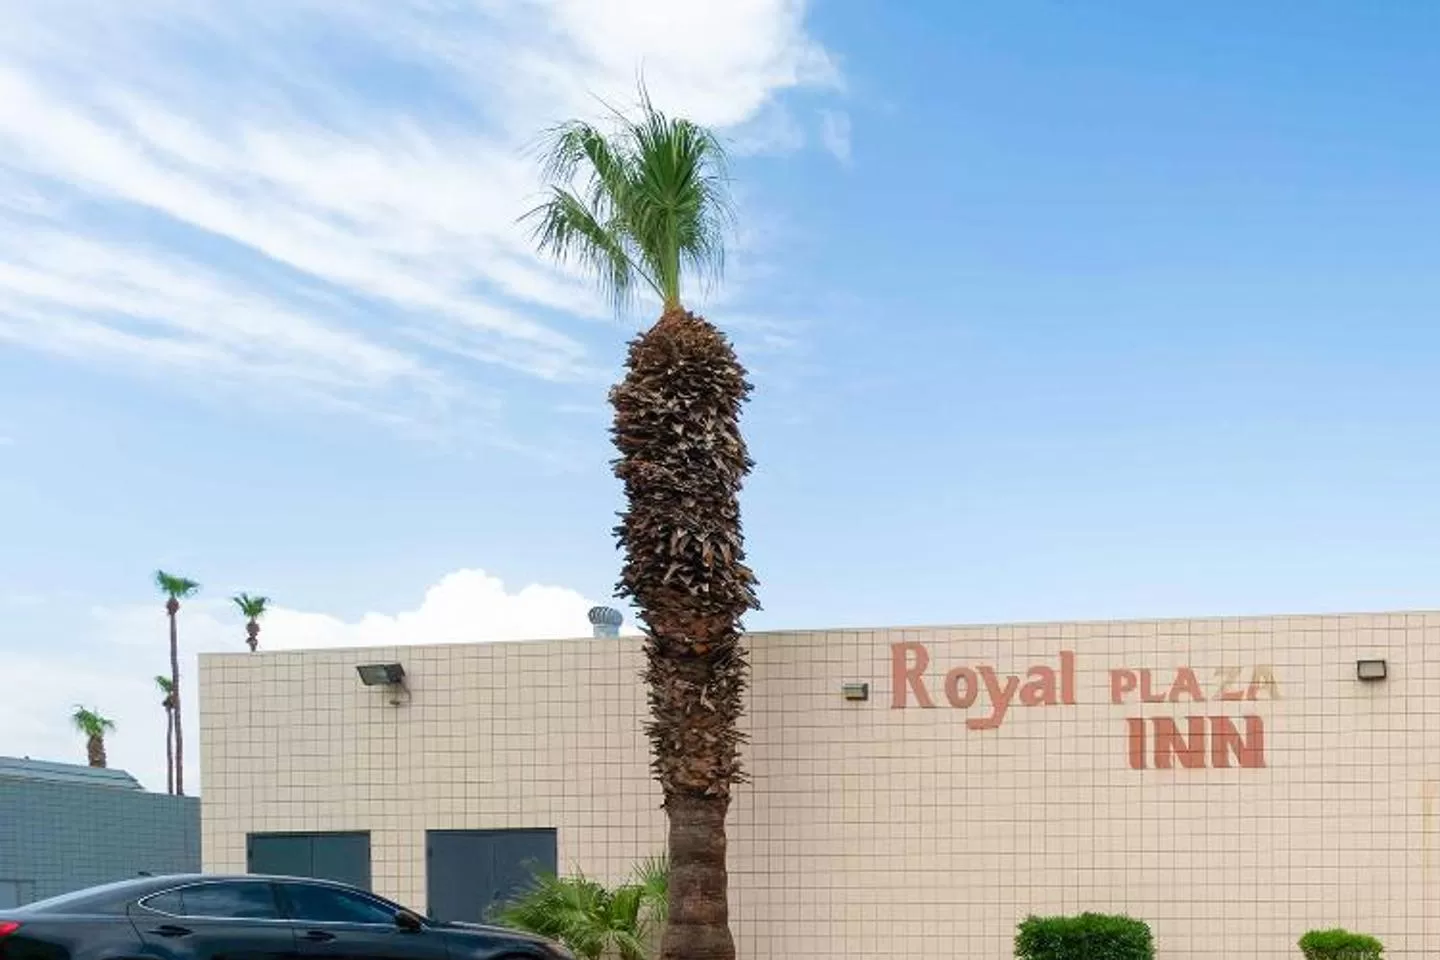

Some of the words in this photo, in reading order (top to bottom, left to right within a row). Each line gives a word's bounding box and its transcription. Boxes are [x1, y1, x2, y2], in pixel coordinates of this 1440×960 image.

[890, 641, 1077, 730] Royal
[1110, 664, 1280, 705] PLAZA
[1126, 715, 1267, 770] INN
